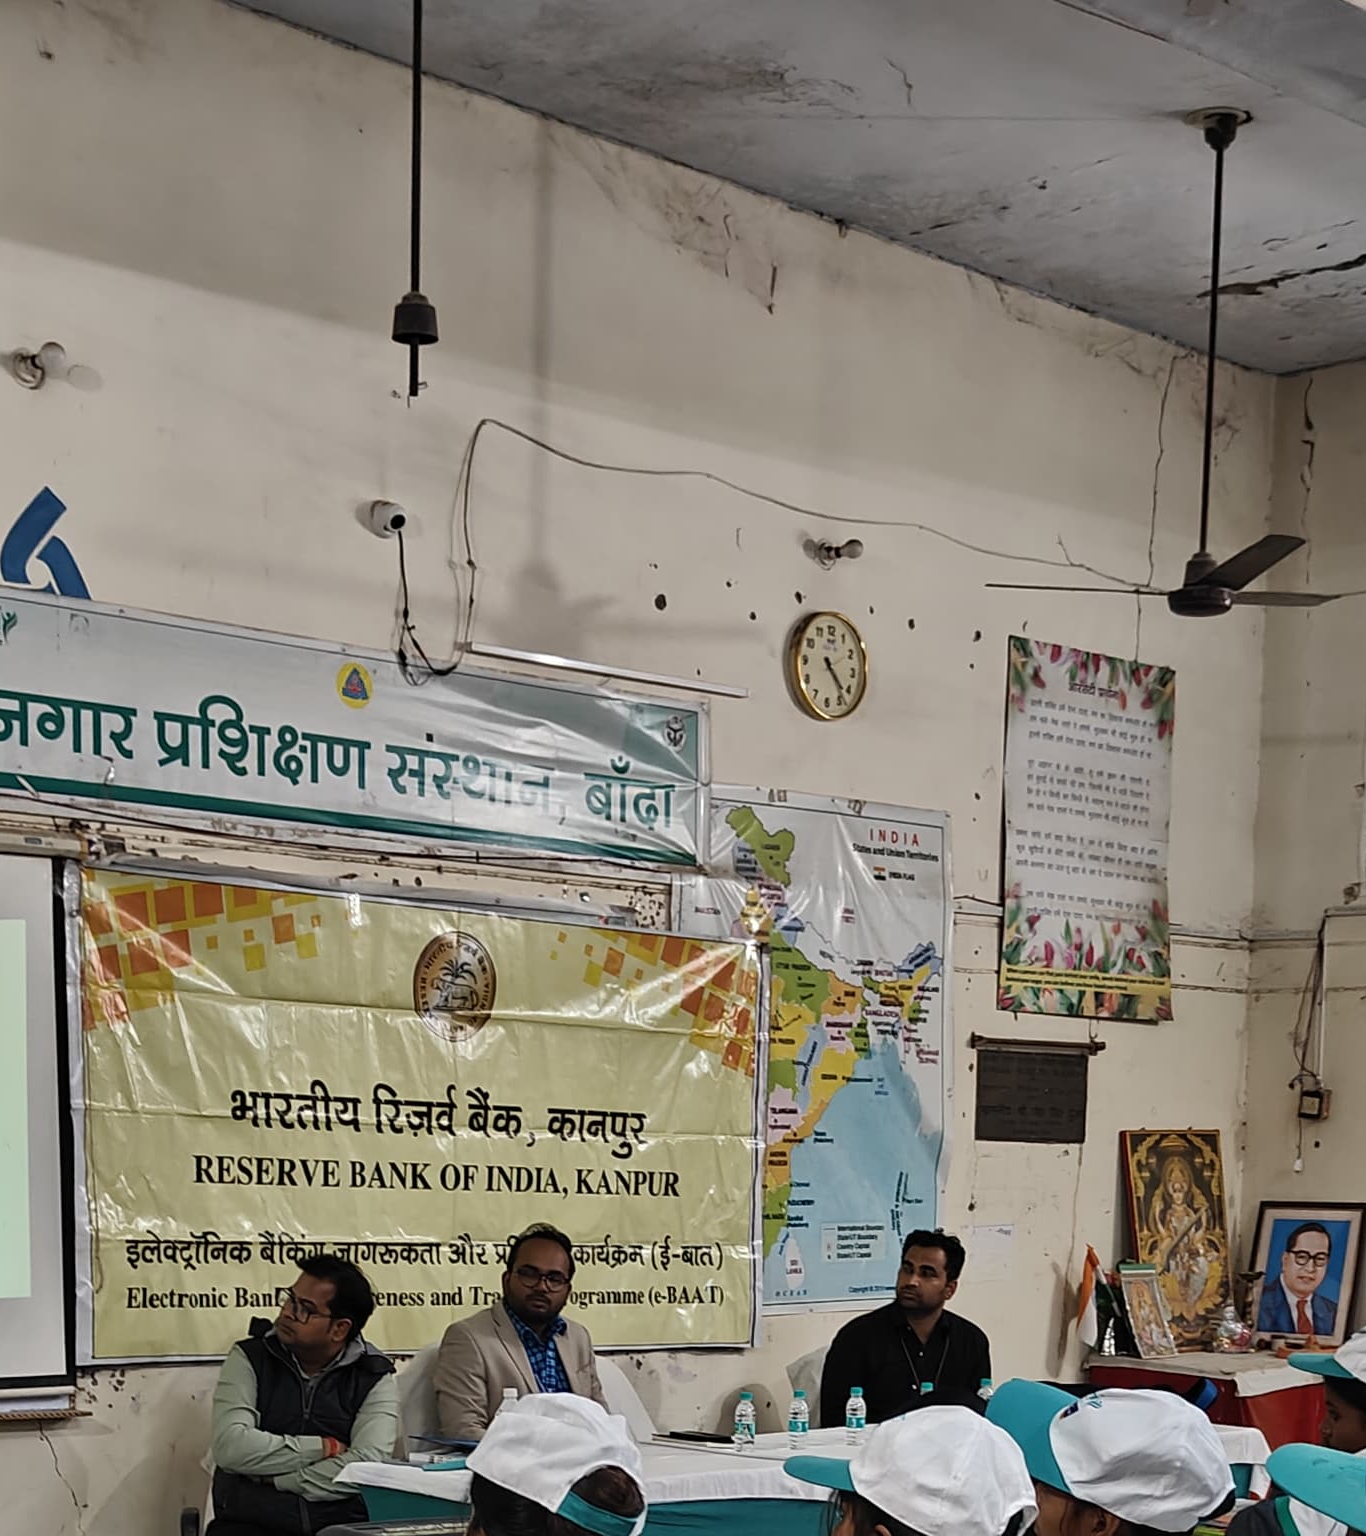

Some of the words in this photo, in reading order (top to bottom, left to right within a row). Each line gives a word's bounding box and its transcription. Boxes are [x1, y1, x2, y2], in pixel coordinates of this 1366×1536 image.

[154, 693, 370, 790] प्रशिक्षण
[869, 828, 920, 847] INDIA
[230, 1078, 361, 1132] भारतीय
[373, 1083, 456, 1137] रिज़र्व
[467, 1087, 537, 1148] बैंक,
[547, 1105, 648, 1159] कानपुर
[193, 1153, 341, 1189] RESERVE
[348, 1159, 434, 1192] BANK
[439, 1162, 479, 1192] OF
[485, 1164, 570, 1200] INDIA,
[575, 1168, 681, 1199] KANPUR
[124, 1229, 253, 1271] इलेक्ट्रॉनिक
[448, 1233, 488, 1267] और
[574, 1234, 644, 1269] कार्यक्रम
[651, 1234, 724, 1271] (ई-बात)
[125, 1286, 228, 1309] Electronic
[430, 1286, 464, 1307] and
[570, 1290, 646, 1311] ogramme
[648, 1285, 726, 1307] (e-BAAT)
